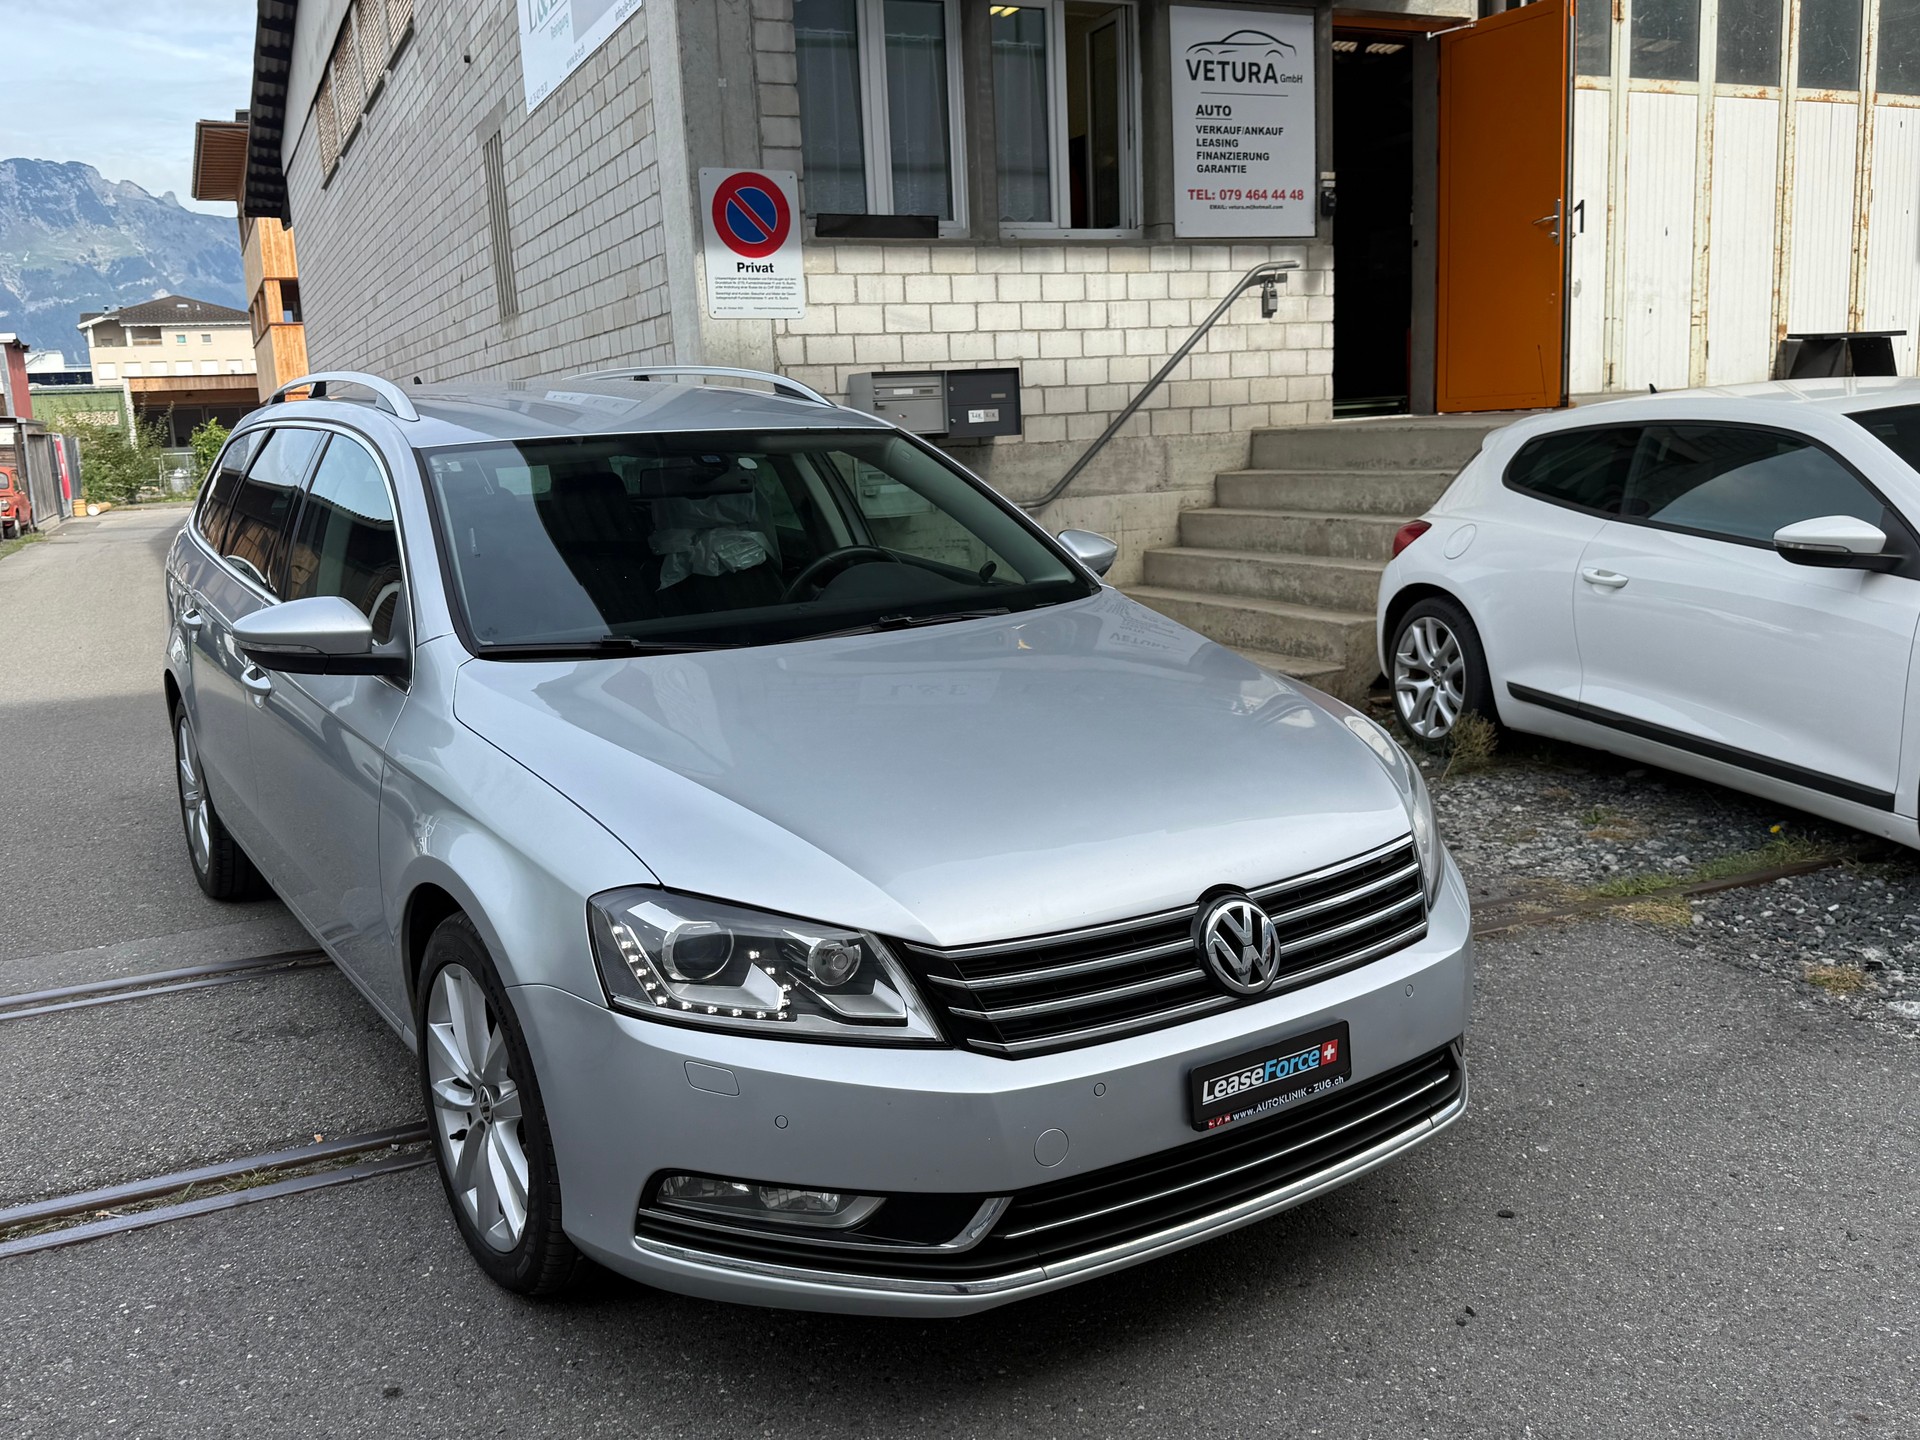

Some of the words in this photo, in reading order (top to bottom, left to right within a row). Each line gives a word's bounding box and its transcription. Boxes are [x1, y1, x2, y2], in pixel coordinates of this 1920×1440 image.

[1185, 59, 1278, 84] VETURA
[1279, 74, 1303, 84] GmbH
[1195, 104, 1232, 117] AUTO
[1195, 125, 1284, 136] VERKAUF/ANKAUF
[1196, 138, 1239, 148] LEASING
[1196, 151, 1270, 161] FINANZIERUNG
[1196, 164, 1247, 174] GARANTIE
[1187, 189, 1216, 200] TEL:
[1219, 189, 1242, 201] 079
[1245, 189, 1268, 201] 464
[1271, 189, 1286, 201] 44
[1289, 189, 1304, 201] 48
[736, 262, 774, 273] Privat
[1202, 1049, 1320, 1103] LeaseForce
[1232, 1087, 1308, 1121] www.AUTOKLINIK
